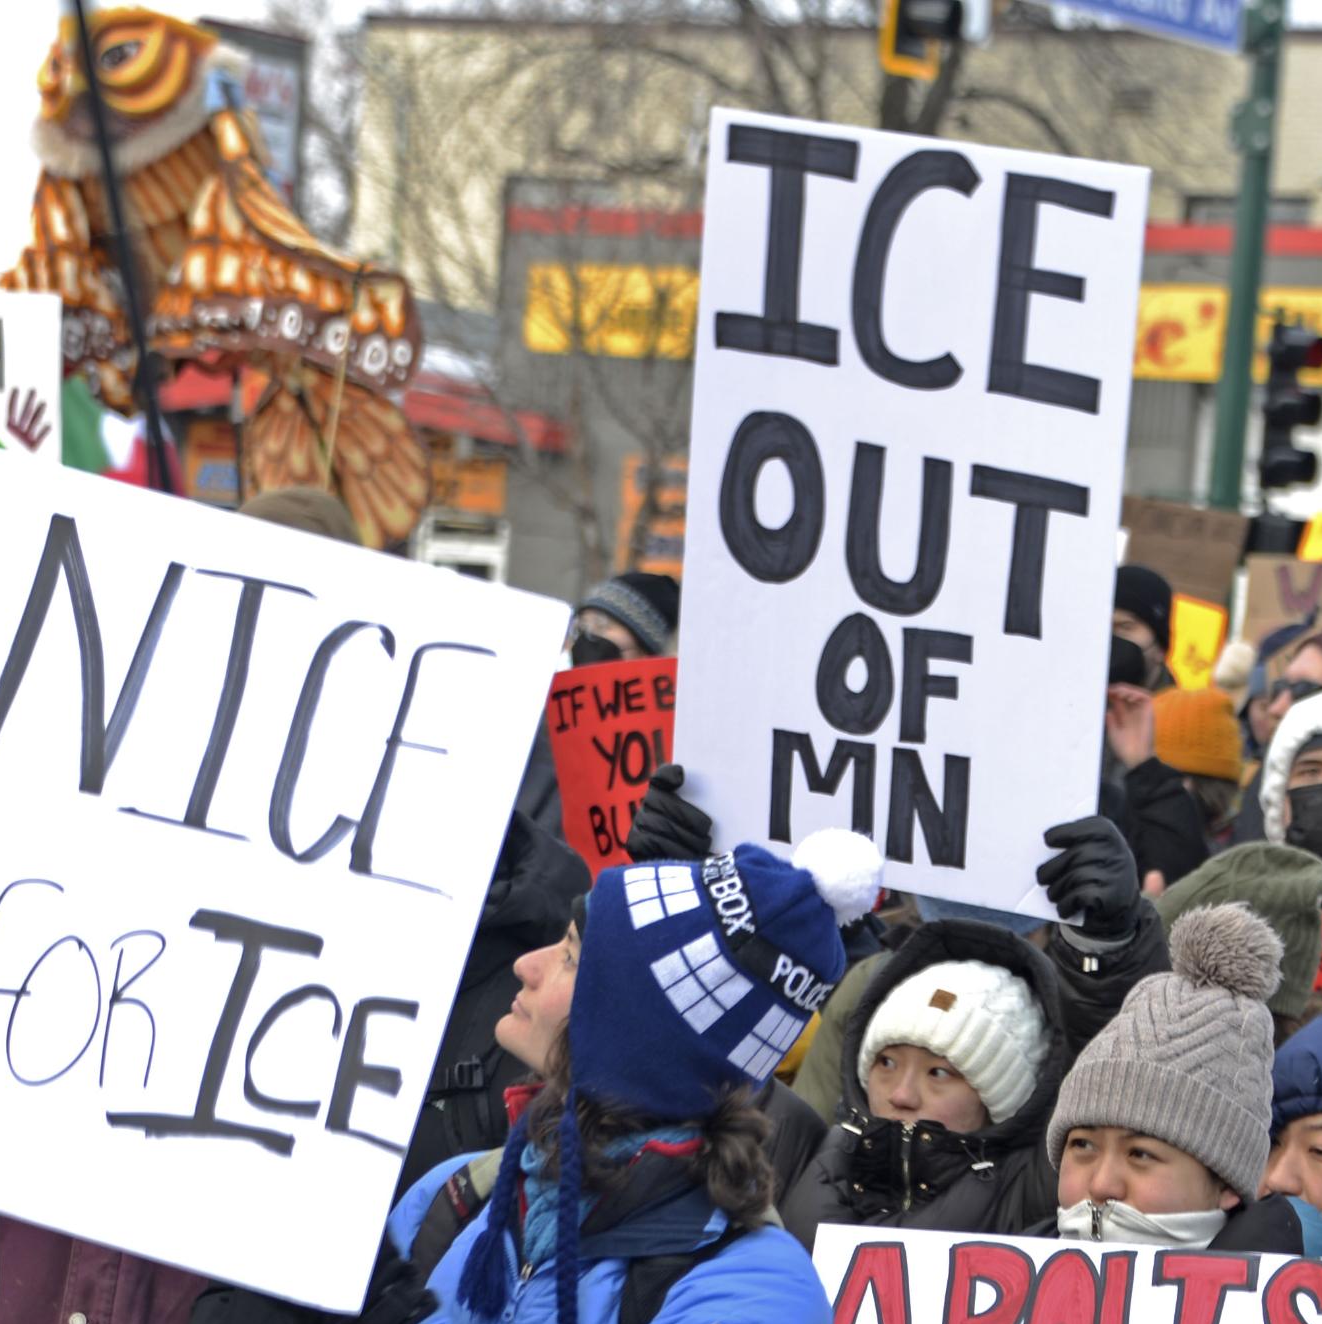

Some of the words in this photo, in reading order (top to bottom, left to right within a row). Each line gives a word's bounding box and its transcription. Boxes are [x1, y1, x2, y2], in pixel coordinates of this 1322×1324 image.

[714, 123, 1117, 414] ICE
[719, 410, 1090, 639] OUT
[551, 685, 586, 733] IF
[593, 678, 645, 720] WE
[816, 613, 973, 743] OF
[768, 728, 970, 870] MN
[709, 877, 756, 936] BOX
[105, 907, 418, 1156] ICE
